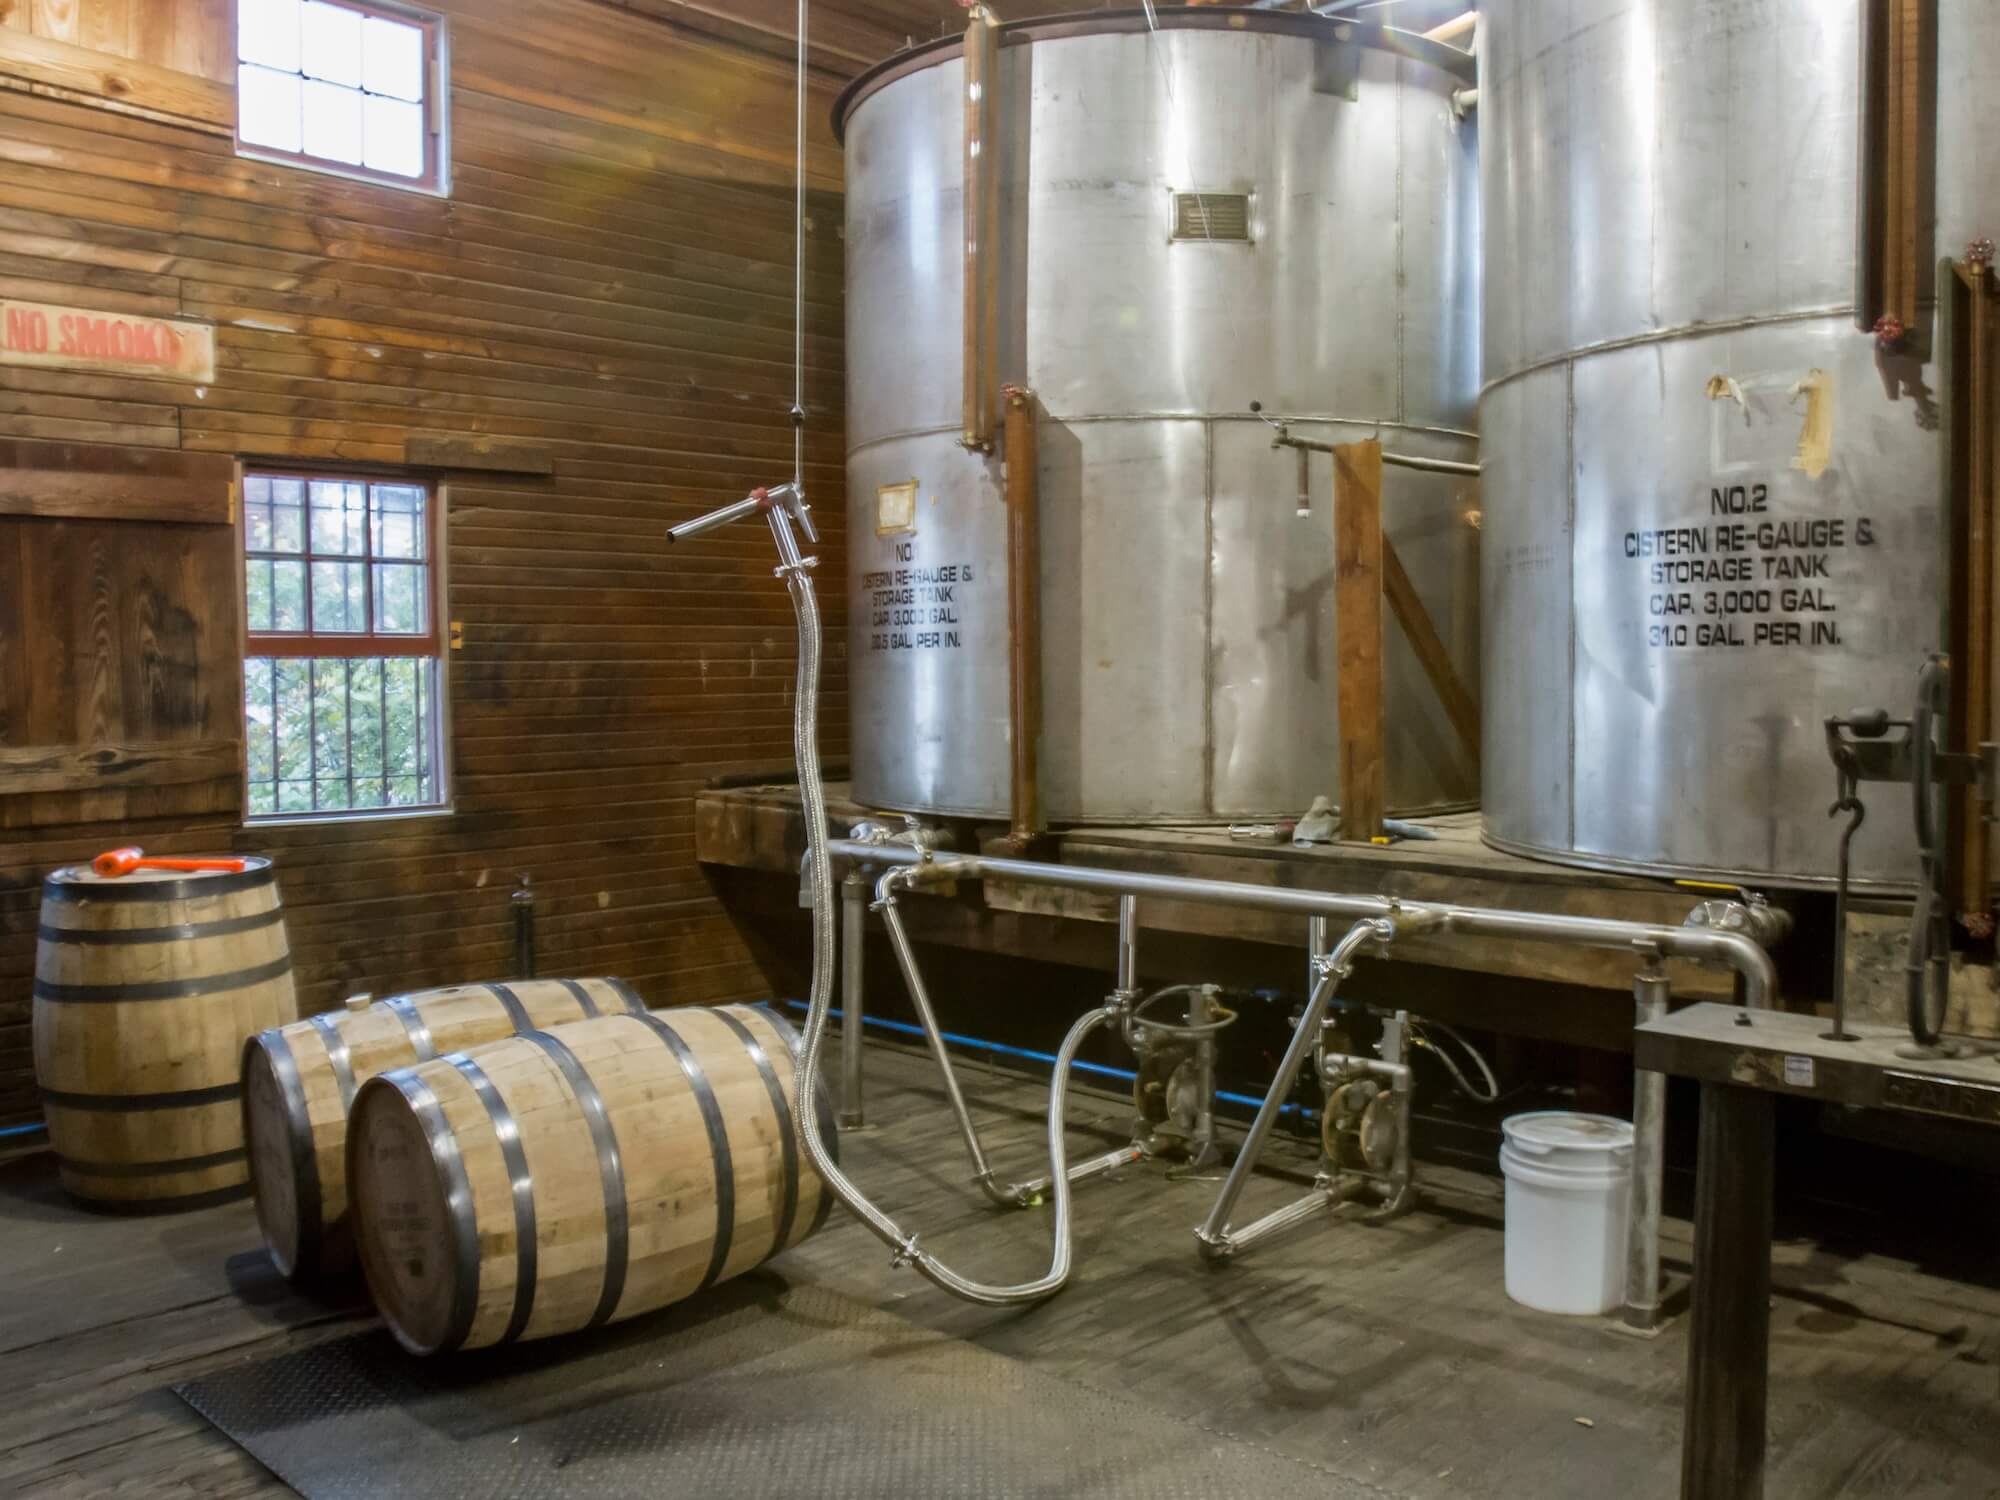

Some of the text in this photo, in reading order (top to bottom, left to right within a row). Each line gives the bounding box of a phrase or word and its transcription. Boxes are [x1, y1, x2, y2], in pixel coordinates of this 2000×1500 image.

[7, 308, 48, 353] NO
[1711, 484, 1768, 515] NO.2
[1624, 518, 1875, 557] CISTERN RE-GAUGE &
[962, 565, 974, 582] &
[1651, 554, 1830, 584] STORAGE TANK
[872, 589, 914, 607] STORAGE
[1650, 588, 1836, 619] CAP. 3,000 GAL.
[929, 608, 957, 624] GAL.
[891, 632, 912, 649] GAL.
[917, 632, 940, 648] PER
[944, 632, 961, 647] IN.
[1649, 621, 1841, 647] 31.0 GAL. PER IN.
